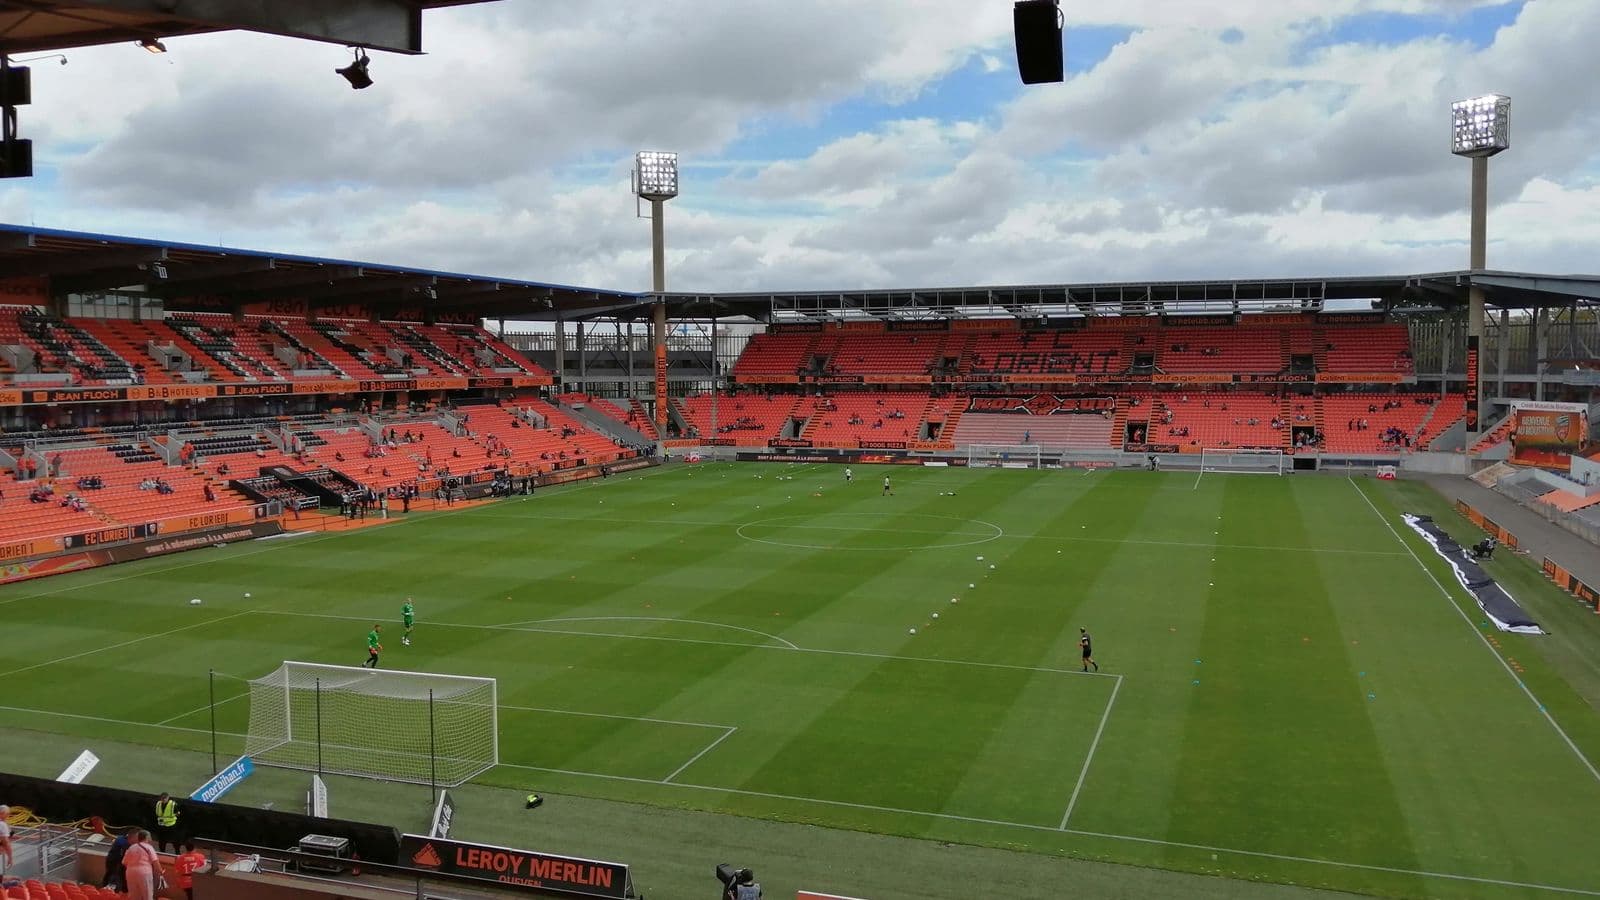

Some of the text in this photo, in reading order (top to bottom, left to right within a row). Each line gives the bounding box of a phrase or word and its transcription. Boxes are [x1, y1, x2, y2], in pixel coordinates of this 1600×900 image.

[53, 390, 119, 402] JEAN FLOCH
[148, 387, 199, 398] B&B HOTELS
[239, 385, 287, 395] JEAN FLOCH
[189, 513, 229, 528] FC LORIENT
[86, 527, 136, 546] FC LORIENT
[202, 762, 245, 802] morbihan.fr
[456, 847, 524, 875] LEROY
[529, 858, 612, 888] MERLIN
